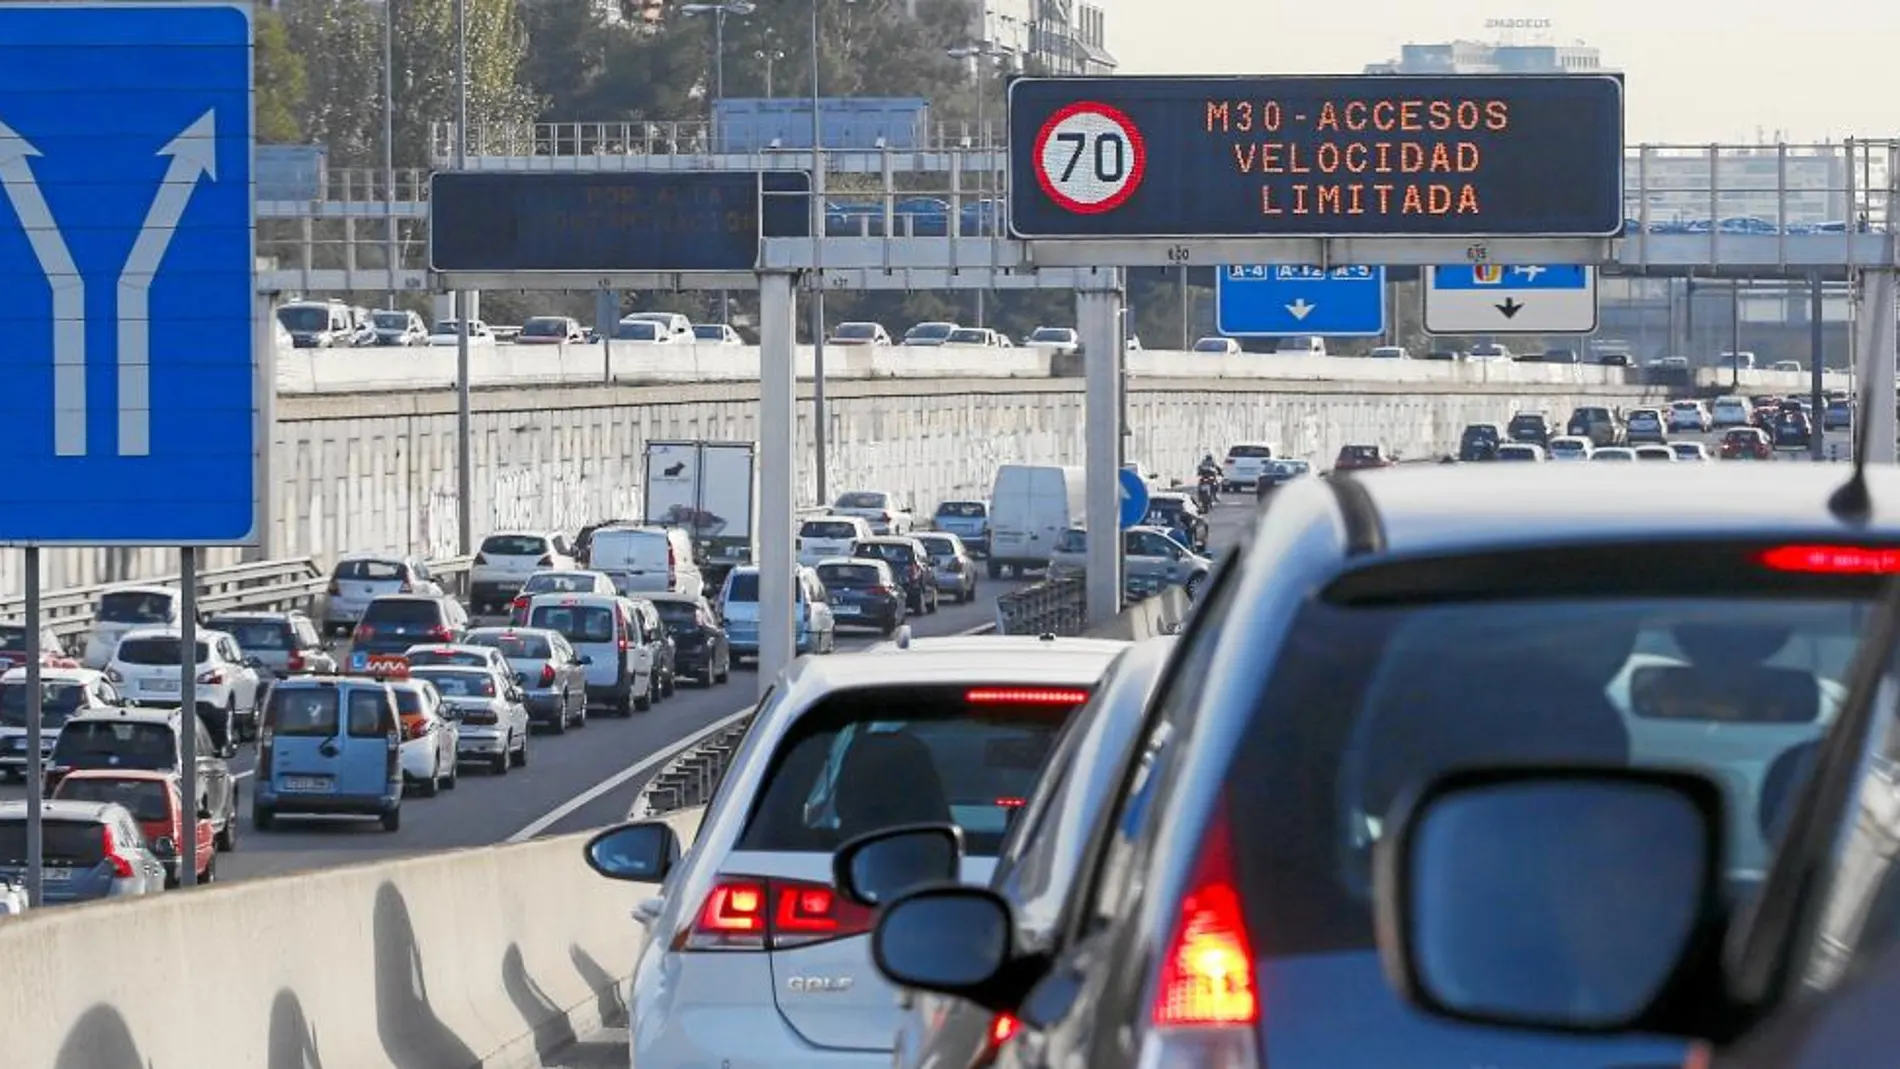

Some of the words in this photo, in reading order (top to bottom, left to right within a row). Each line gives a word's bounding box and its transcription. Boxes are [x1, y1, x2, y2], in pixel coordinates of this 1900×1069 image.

[1057, 132, 1123, 182] 70
[1235, 142, 1480, 172] VELOCIDAD
[1262, 183, 1479, 214] LIMITADA
[1233, 265, 1264, 277] A-4
[788, 976, 854, 993] GOLF
